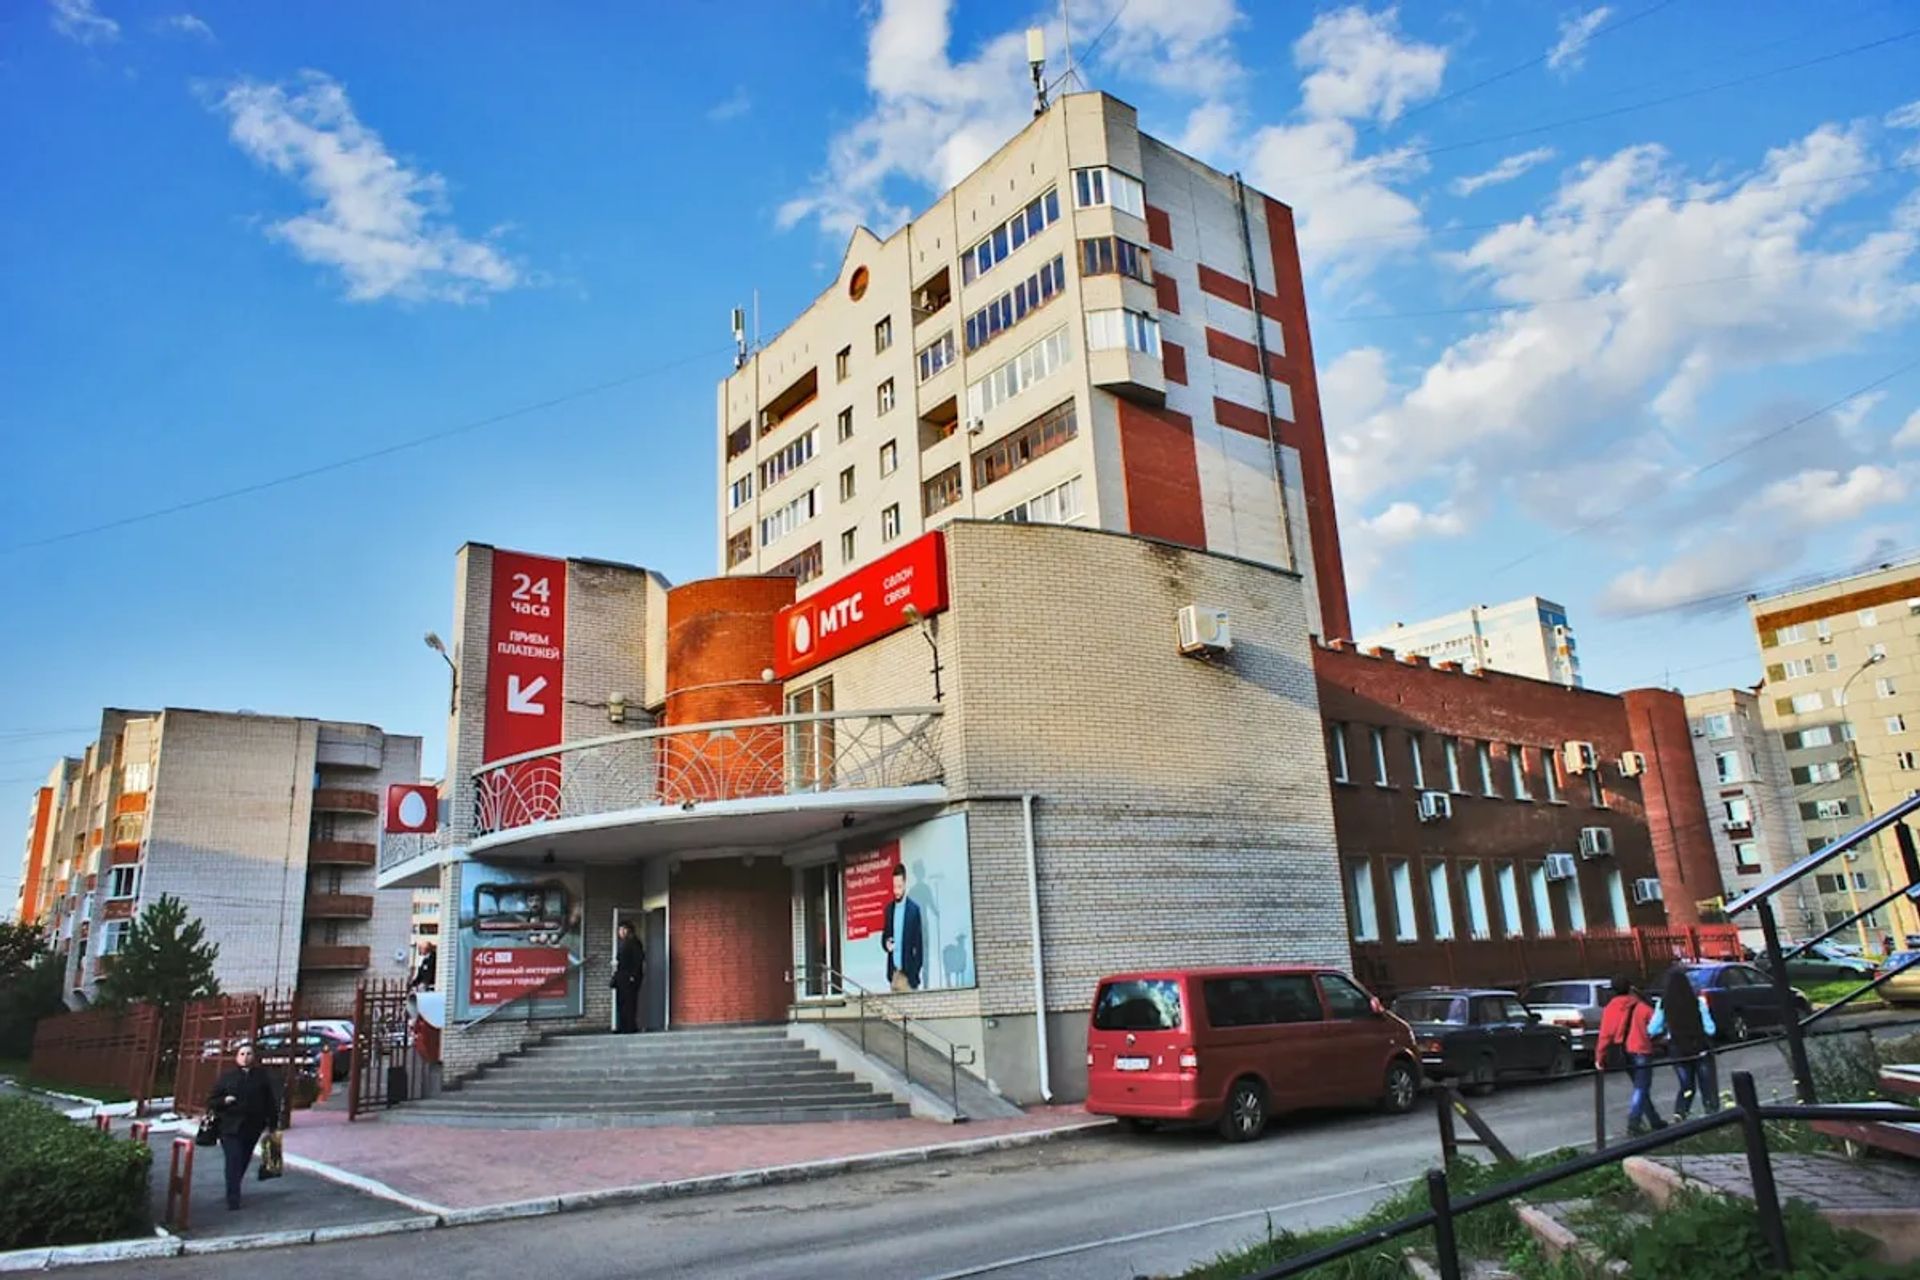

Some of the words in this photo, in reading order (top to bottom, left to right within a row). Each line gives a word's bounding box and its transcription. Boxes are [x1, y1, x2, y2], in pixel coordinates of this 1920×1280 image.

[512, 573, 550, 603] 24
[511, 601, 550, 617] часа
[820, 592, 864, 638] МТС
[510, 630, 549, 646] ПРИЕМ
[498, 643, 560, 660] ПЛАТЕЖЕЙ
[476, 952, 493, 965] 4G
